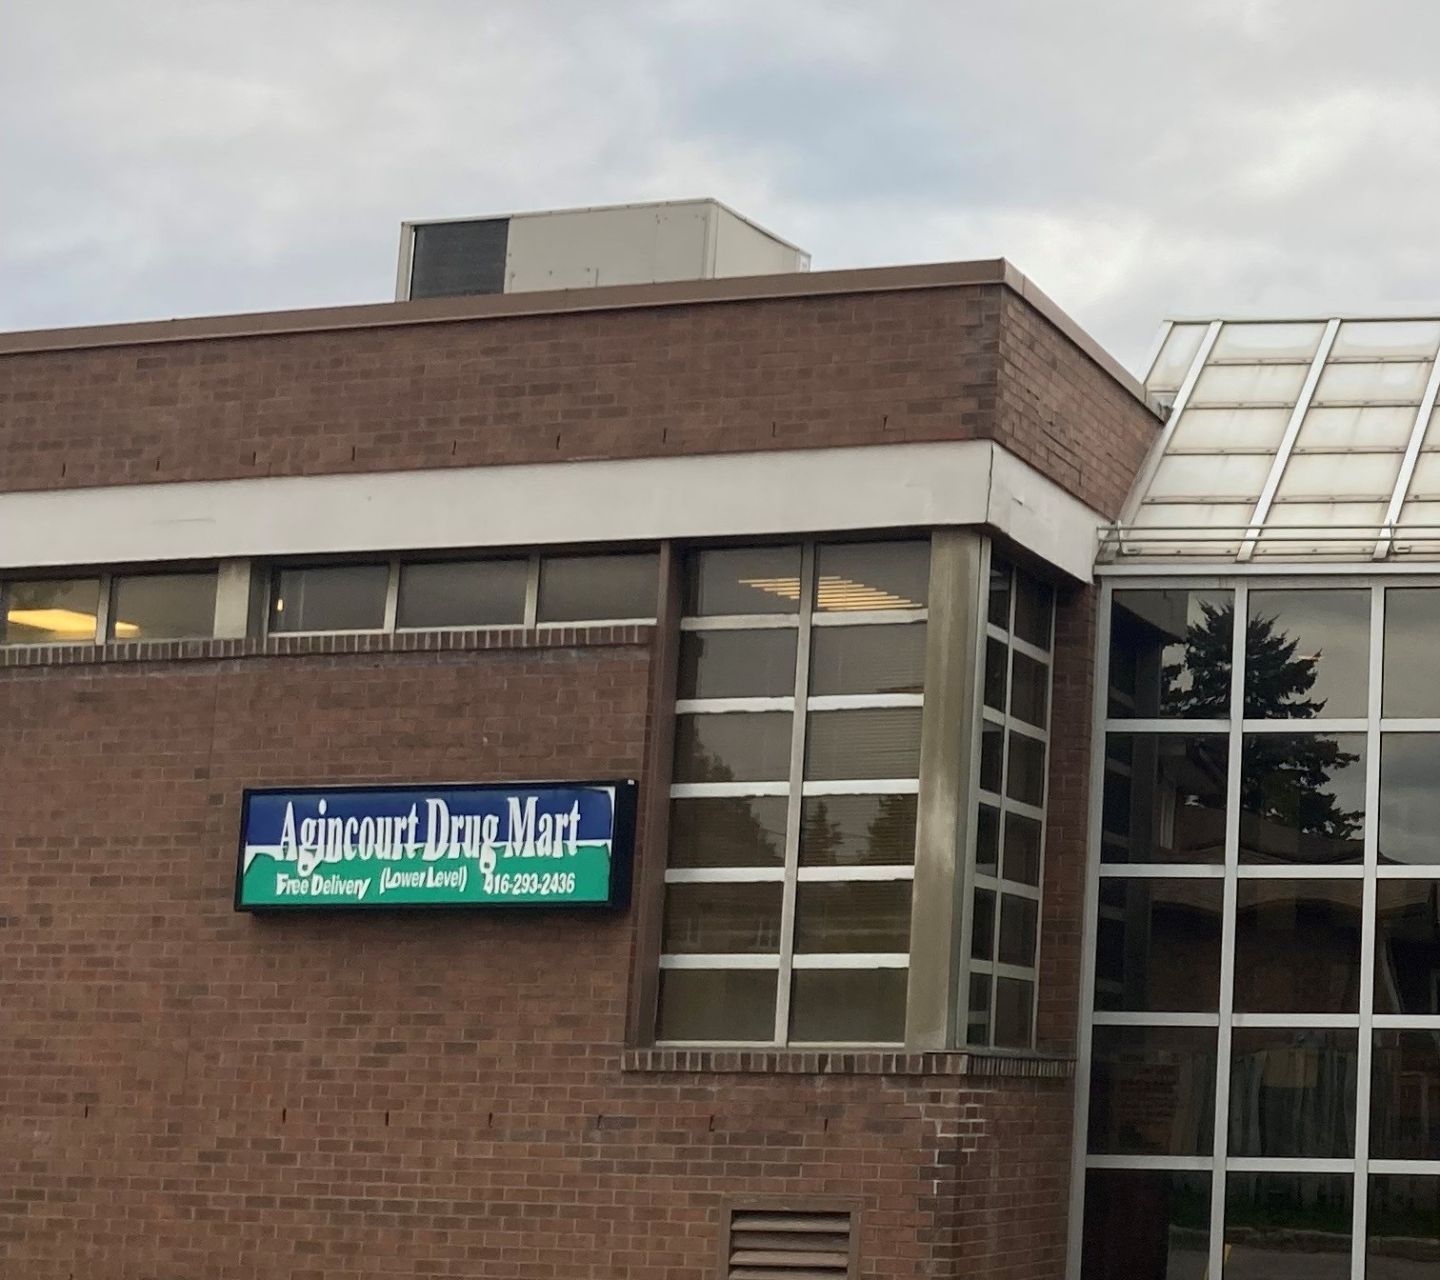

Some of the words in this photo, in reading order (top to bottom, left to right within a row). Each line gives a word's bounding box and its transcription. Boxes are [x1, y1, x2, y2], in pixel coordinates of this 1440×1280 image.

[275, 798, 420, 877] Agincourt
[422, 797, 499, 874] Drug
[504, 796, 581, 858] Mart
[276, 872, 308, 895] Free
[311, 873, 371, 900] Delivery
[379, 866, 425, 894] (Lower
[426, 865, 467, 892] Level)
